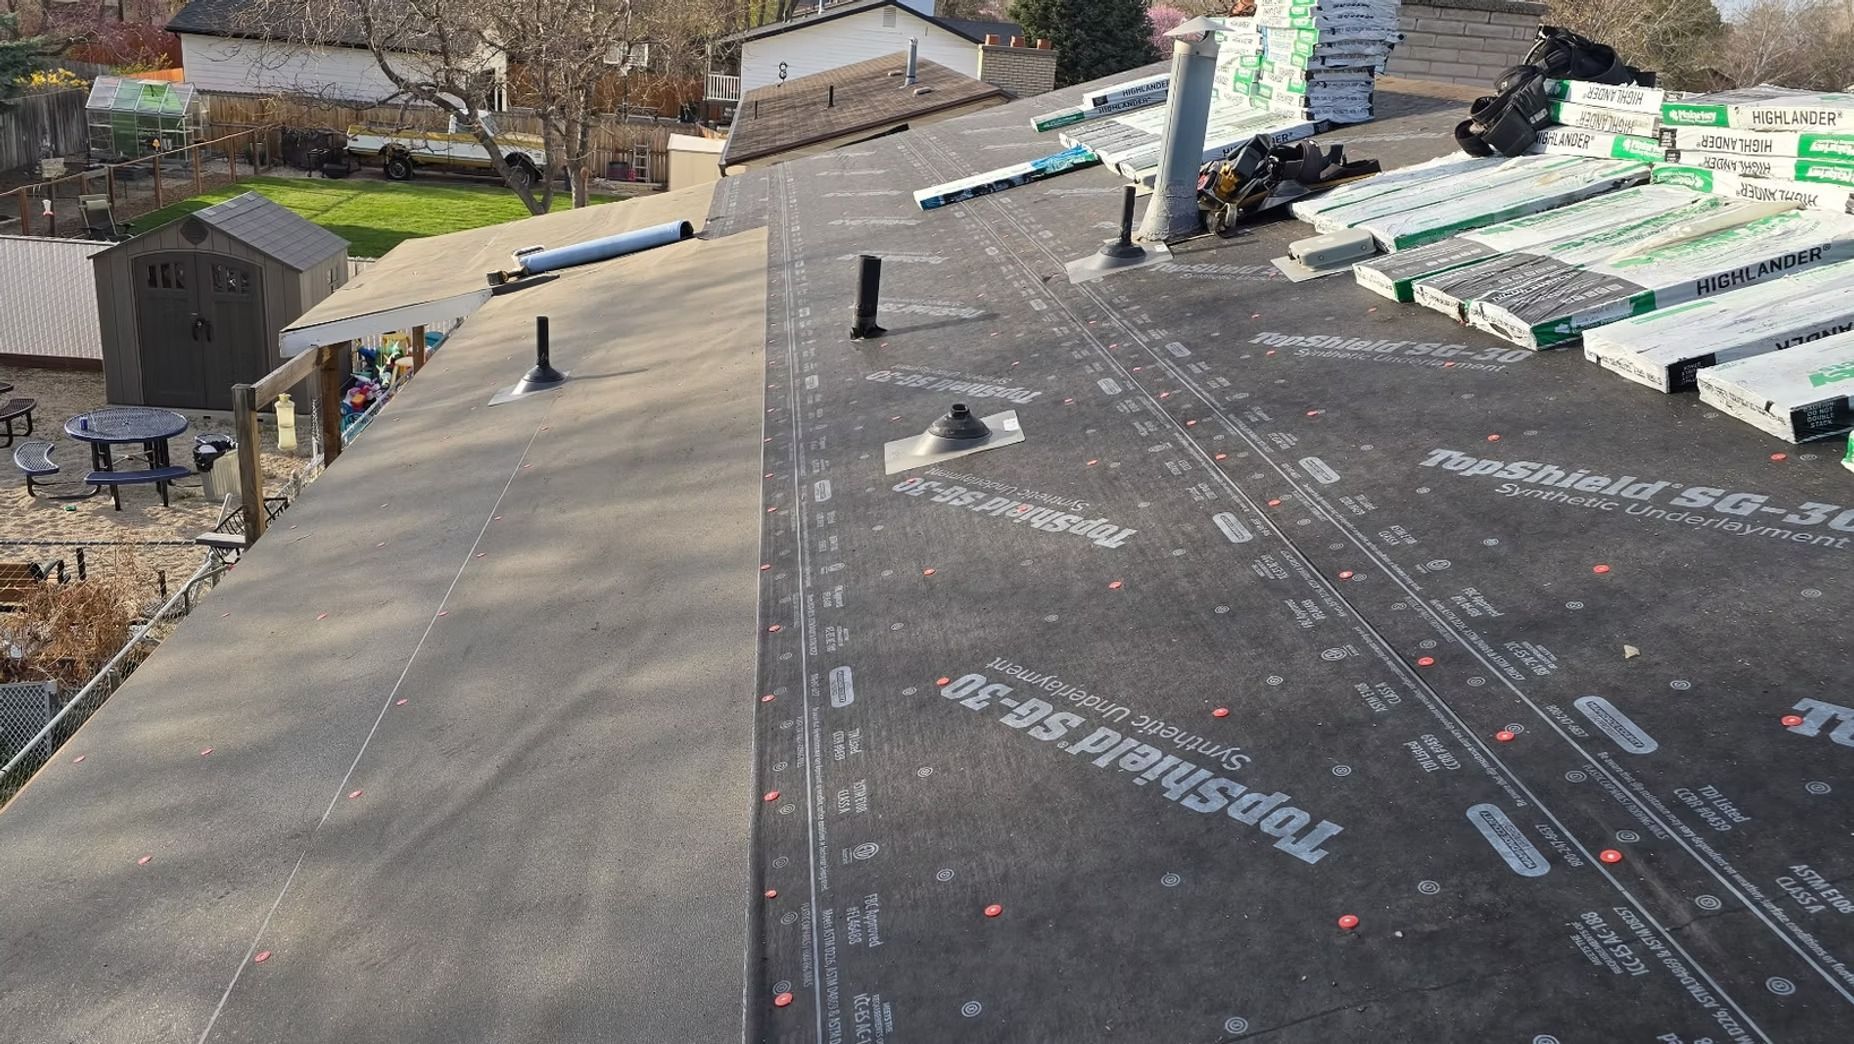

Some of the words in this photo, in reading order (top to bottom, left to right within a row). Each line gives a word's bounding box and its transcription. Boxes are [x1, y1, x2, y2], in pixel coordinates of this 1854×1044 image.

[1373, 353, 1508, 372] Underlament
[1404, 342, 1533, 363] SG-30
[1807, 413, 1834, 423] DOUBLE
[1810, 420, 1833, 428] STACK
[1819, 407, 1834, 415] NOT
[892, 477, 988, 507] SG-30
[923, 466, 1018, 495] Underlayment
[1017, 488, 1090, 512] Synthetic
[1495, 483, 1620, 511] Synthetic
[1624, 503, 1851, 550] Underlayment
[985, 656, 1131, 724] Underlayment
[940, 673, 1087, 743] SG-30
[1130, 714, 1252, 772] Synthetic
[1403, 740, 1432, 762] Listed
[1420, 758, 1441, 773] TDI
[1673, 788, 1703, 809] CCRR
[1694, 806, 1732, 832] #0439
[1698, 785, 1723, 802] TDI
[1713, 796, 1751, 823] Listed
[864, 893, 879, 909] FBC
[1679, 824, 1697, 838] vary
[1691, 836, 1729, 867] dependent
[1723, 865, 1737, 874] on
[1760, 899, 1790, 923] surface
[1785, 922, 1828, 956] conditions
[1822, 955, 1837, 964] or
[1776, 877, 1817, 905] CLASS
[1805, 905, 1826, 914] A
[1789, 865, 1832, 890] ASTM
[1820, 888, 1854, 914] E108
[863, 908, 884, 947] Approved
[1580, 911, 1622, 944] AC-188
[1613, 906, 1644, 930] D8257
[824, 928, 836, 946] ASTM
[1635, 928, 1665, 950] ASTM
[1609, 944, 1650, 976] ICC-ES
[1656, 949, 1672, 958] &
[825, 967, 838, 986] ASTM
[1662, 958, 1696, 985] D4869
[853, 992, 871, 1024] ICC-ES
[1686, 982, 1720, 1008] ASTM
[829, 1017, 841, 1038] ASTM
[1712, 1008, 1745, 1036] D226,
